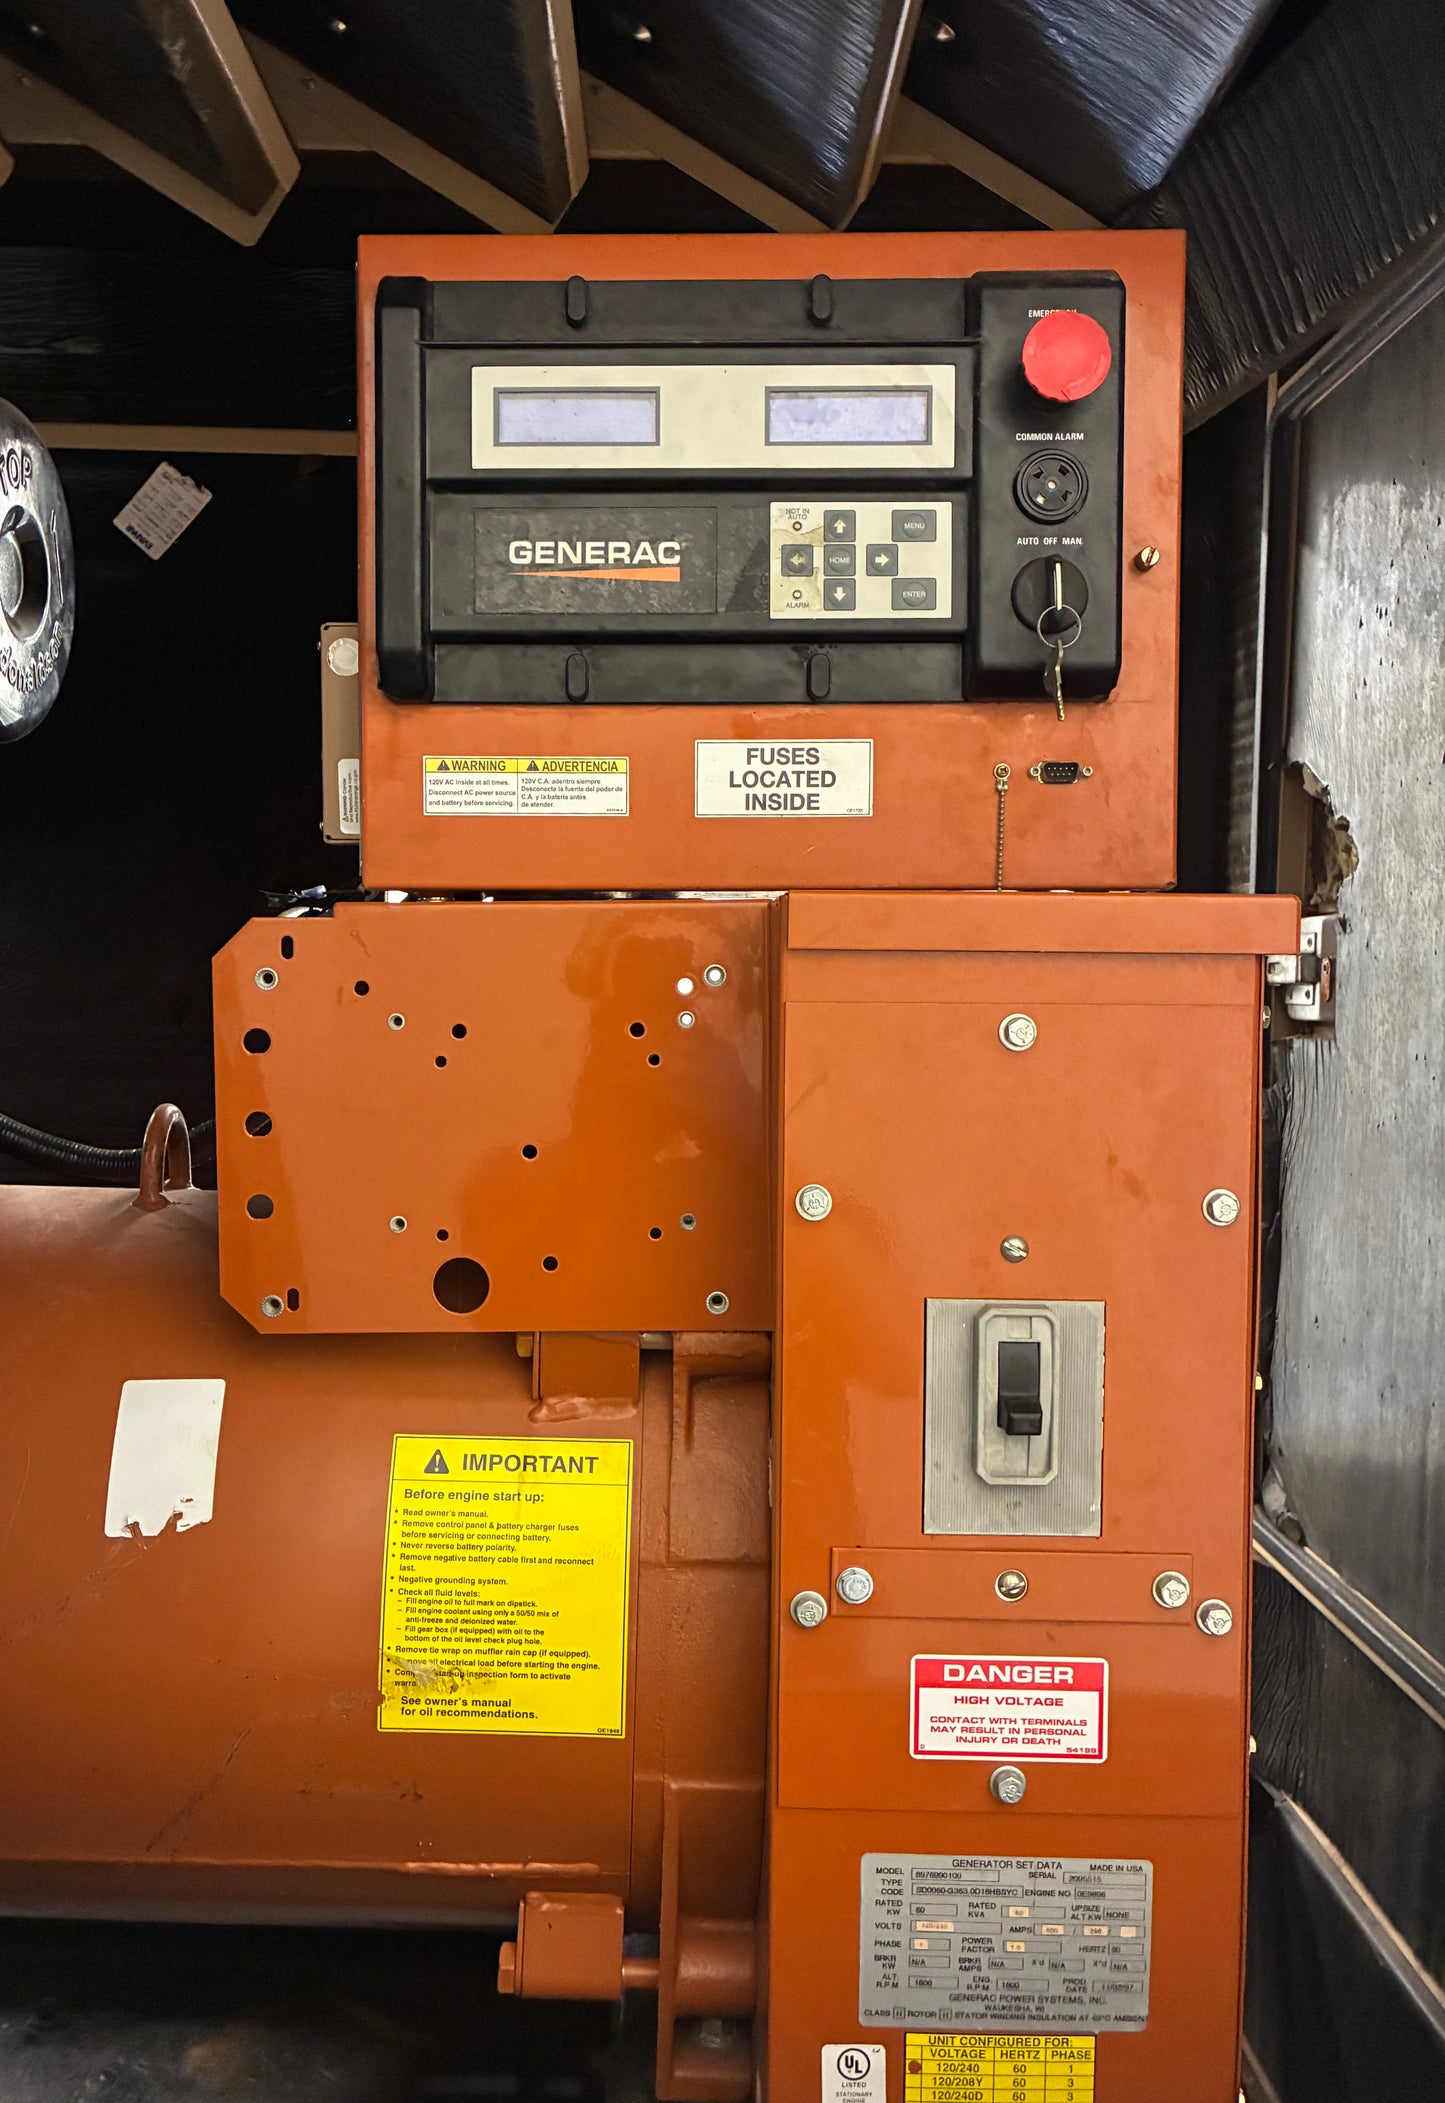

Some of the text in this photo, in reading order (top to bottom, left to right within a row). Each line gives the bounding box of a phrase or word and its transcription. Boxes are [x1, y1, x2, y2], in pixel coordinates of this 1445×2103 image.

[1015, 432, 1084, 441] COMMON ALARM
[784, 507, 810, 516] NOT IN
[786, 513, 808, 521] AUTO
[903, 522, 925, 530] MENU
[1016, 536, 1039, 546] AUTO
[1042, 536, 1058, 545] OFF
[508, 540, 683, 565] GENERAC
[829, 556, 851, 564] HOME
[902, 590, 926, 598] ENTER
[785, 601, 810, 609] ALARM
[746, 746, 820, 766] FUSES
[451, 759, 507, 772] WARNING
[541, 760, 619, 773] ADVERTENCIA
[428, 778, 444, 786] 120V
[444, 778, 455, 786] AC
[455, 778, 475, 786] inside
[728, 769, 837, 788] LOCATED
[428, 788, 463, 796] Disconnect
[463, 788, 474, 796] AC
[441, 799, 463, 807] battery
[484, 799, 514, 808] servicing.
[744, 792, 821, 811] INSIDE
[462, 1453, 600, 1473] IMPORTANT
[403, 1488, 544, 1505] Before engine start up:
[402, 1507, 489, 1518] Read owner's manual.
[401, 1519, 580, 1533] Remove control panel & battery charger fuses
[400, 1530, 427, 1539] before
[427, 1531, 465, 1541] servicing
[476, 1533, 521, 1543] connecting
[521, 1533, 552, 1543] battery.
[399, 1540, 517, 1553] Never reverse battery polarity.
[399, 1552, 594, 1566] Remove negative battery cable first and reconnect
[398, 1563, 416, 1572] last.
[397, 1574, 509, 1586] Negative grounding system.
[397, 1587, 481, 1598] Check all fluid levels:
[394, 1644, 428, 1654] Remove
[428, 1646, 440, 1654] tie
[440, 1647, 461, 1656] wrap
[474, 1647, 504, 1656] muffler
[504, 1648, 521, 1656] rain
[521, 1649, 538, 1658] cap
[538, 1648, 548, 1658] (if
[548, 1649, 591, 1659] equipped).
[943, 1664, 1074, 1684] DANGER
[400, 1695, 512, 1708] See owner's manual
[953, 1695, 1064, 1707] HIGH VOLTAGE
[400, 1705, 538, 1719] for oil recommendations.
[929, 1715, 1088, 1727] CONTACT WITH TERMINALS
[929, 1725, 1087, 1736] MAY RESULT IN PERSONAL
[955, 1735, 1061, 1745] INJURY OR DEATH
[951, 1858, 1063, 1871] GENERATOR SET DATA
[1088, 1863, 1143, 1874] MADE IN USA
[875, 1866, 905, 1875] MODEL
[1027, 1870, 1057, 1879] SERIAL
[880, 1878, 903, 1887] TYPE
[880, 1887, 904, 1896] CODE
[1024, 1888, 1072, 1898] ENGINE NO
[874, 1898, 904, 1907] RATED
[967, 1901, 997, 1910] RATED
[886, 1907, 901, 1916] KW
[967, 1910, 985, 1918] KVA
[874, 1921, 902, 1930] VOLTS
[1008, 1925, 1034, 1935] AMPS
[873, 1939, 902, 1948] PHASE
[960, 1936, 993, 1945] POWER
[960, 1945, 996, 1954] FACTOR
[1078, 1945, 1107, 1954] HERTZ
[948, 1992, 997, 2005] GENERAC
[998, 1993, 1036, 2006] POWER
[926, 2035, 955, 2048] UNIT
[959, 2036, 1041, 2049] CONFIGURED
[929, 2048, 1092, 2061] VOLTAGE HERTZ PHASE
[844, 2054, 863, 2074] UL
[935, 2062, 1073, 2076] 120/240 60 1
[932, 2076, 1074, 2089] 120/208Y 60 3
[835, 2091, 873, 2099] STATIONARY
[931, 2090, 1074, 2103] 120/240D 60 3
